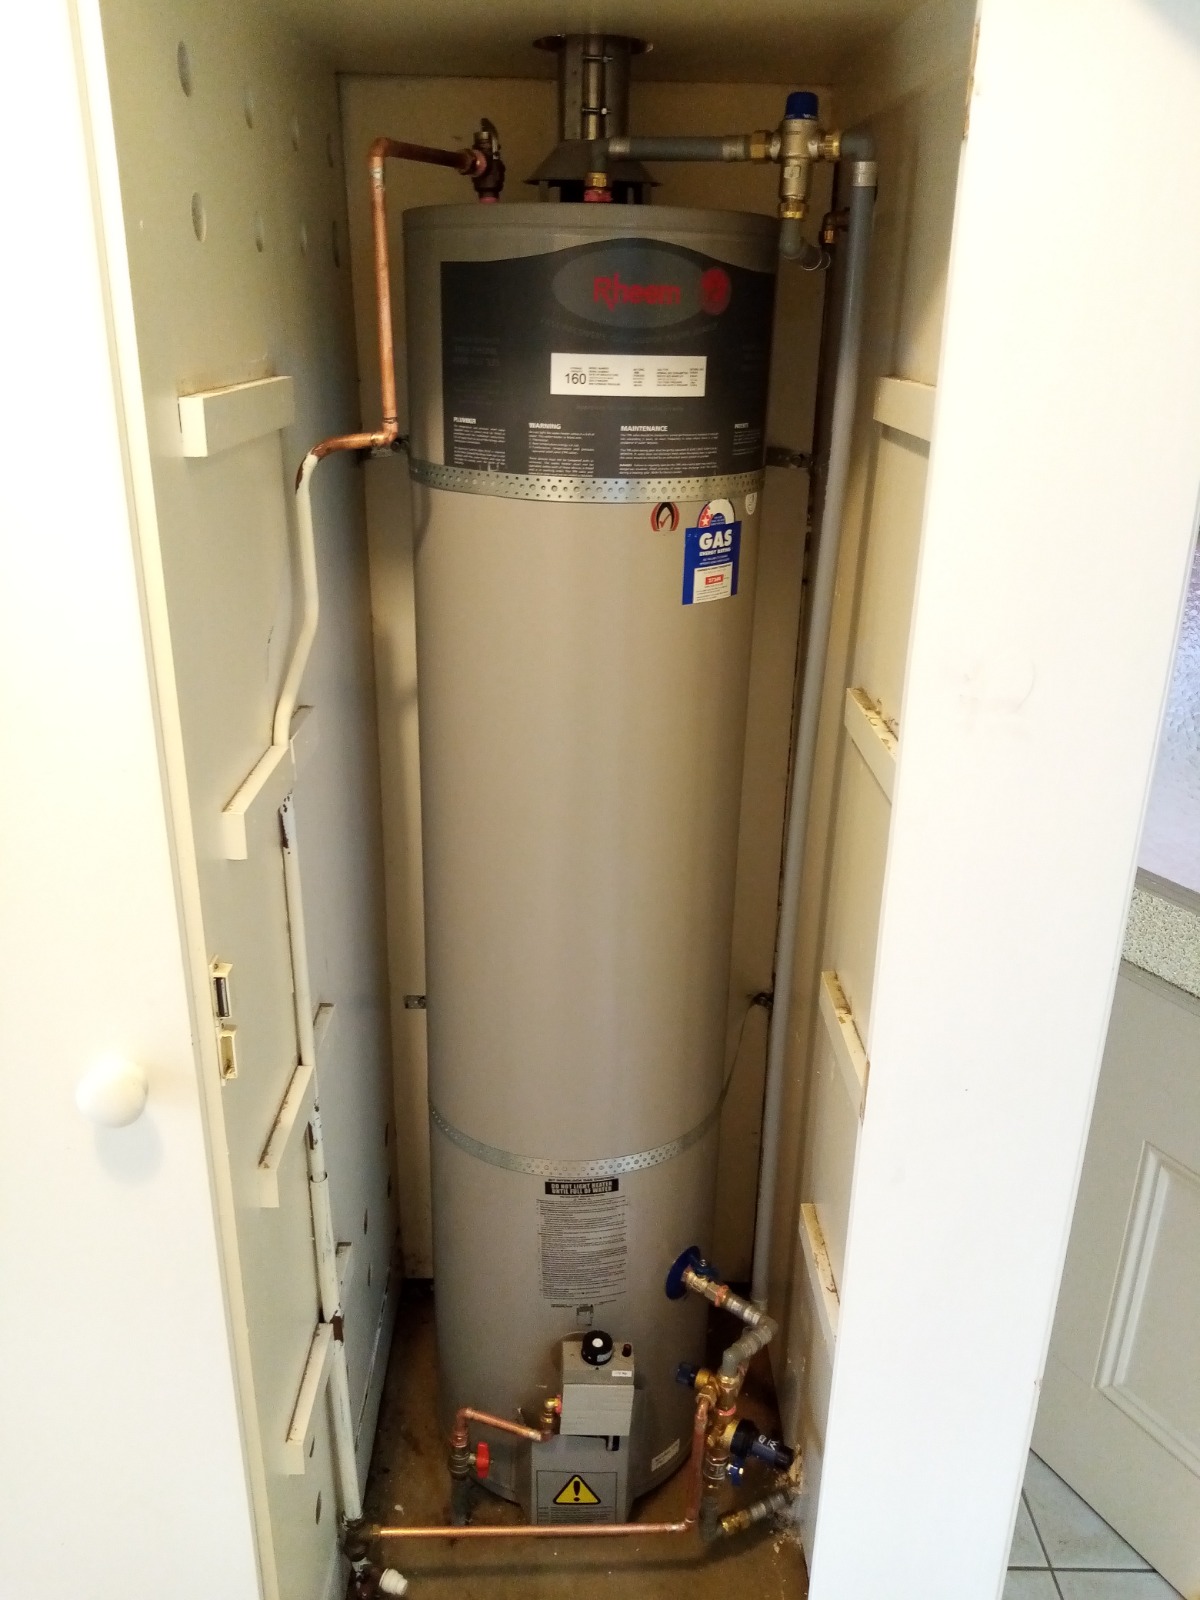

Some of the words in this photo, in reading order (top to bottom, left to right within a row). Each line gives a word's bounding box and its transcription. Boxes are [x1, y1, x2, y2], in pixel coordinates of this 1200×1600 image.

[593, 272, 681, 312] Rheem
[565, 373, 587, 385] 160
[528, 422, 562, 430] WARNING
[699, 529, 733, 550] GAS
